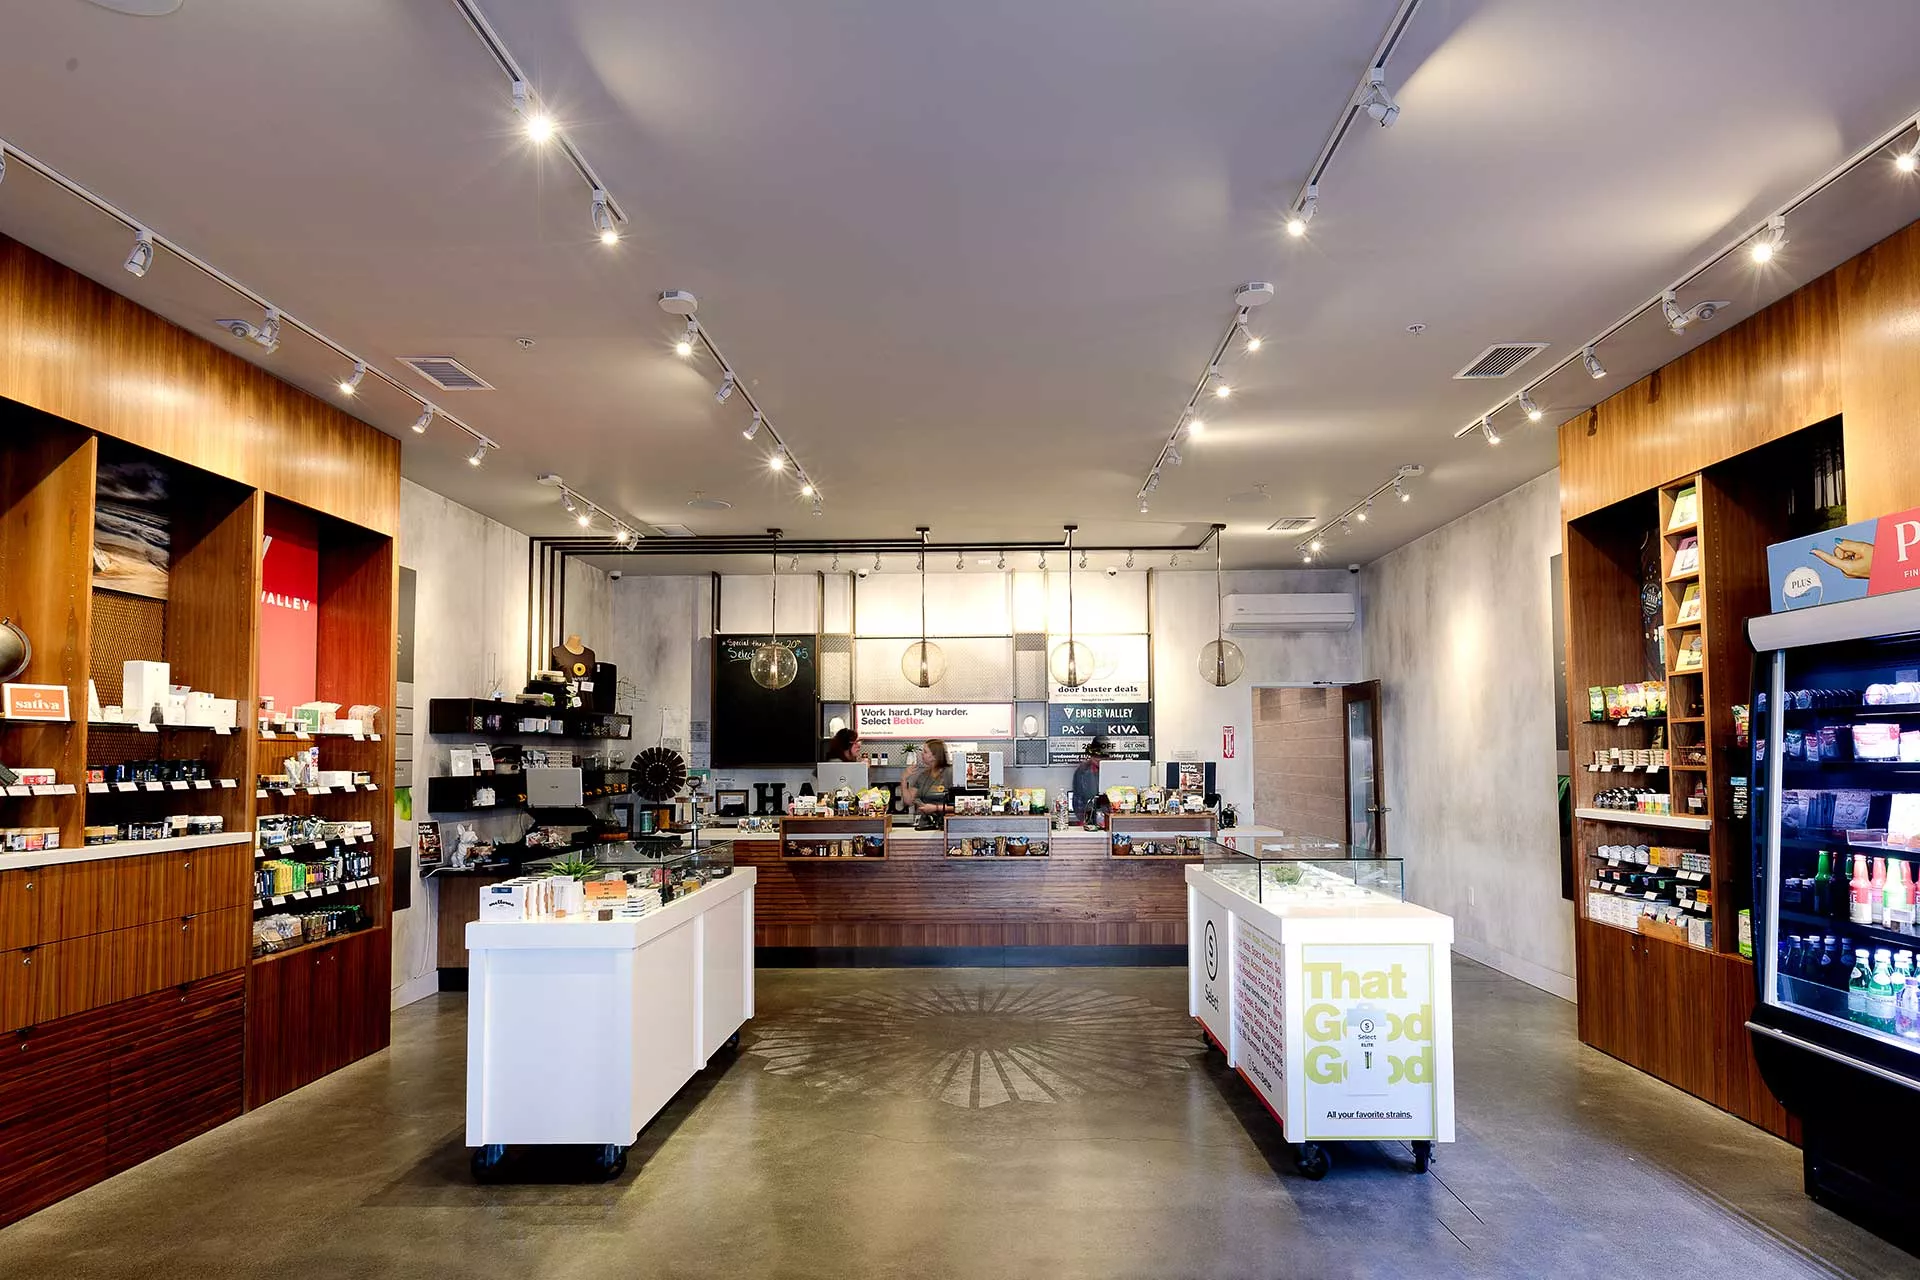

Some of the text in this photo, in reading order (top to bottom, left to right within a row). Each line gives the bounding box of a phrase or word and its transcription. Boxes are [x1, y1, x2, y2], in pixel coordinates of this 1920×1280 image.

[1791, 577, 1812, 589] PLUS
[1058, 685, 1139, 693] door buster deals
[15, 699, 60, 710] sativa
[860, 708, 969, 718] Work hard. Play harder.
[1075, 708, 1133, 718] EMBER VALLEY
[860, 717, 925, 725] Select Better.
[1062, 725, 1140, 735] PAX KIVA
[1100, 742, 1117, 750] OFF
[1303, 962, 1408, 1000] That
[1205, 983, 1220, 1013] Select
[1304, 1003, 1432, 1042] God
[1304, 1045, 1433, 1085] God
[1326, 1111, 1413, 1120] All your favorite strains.
